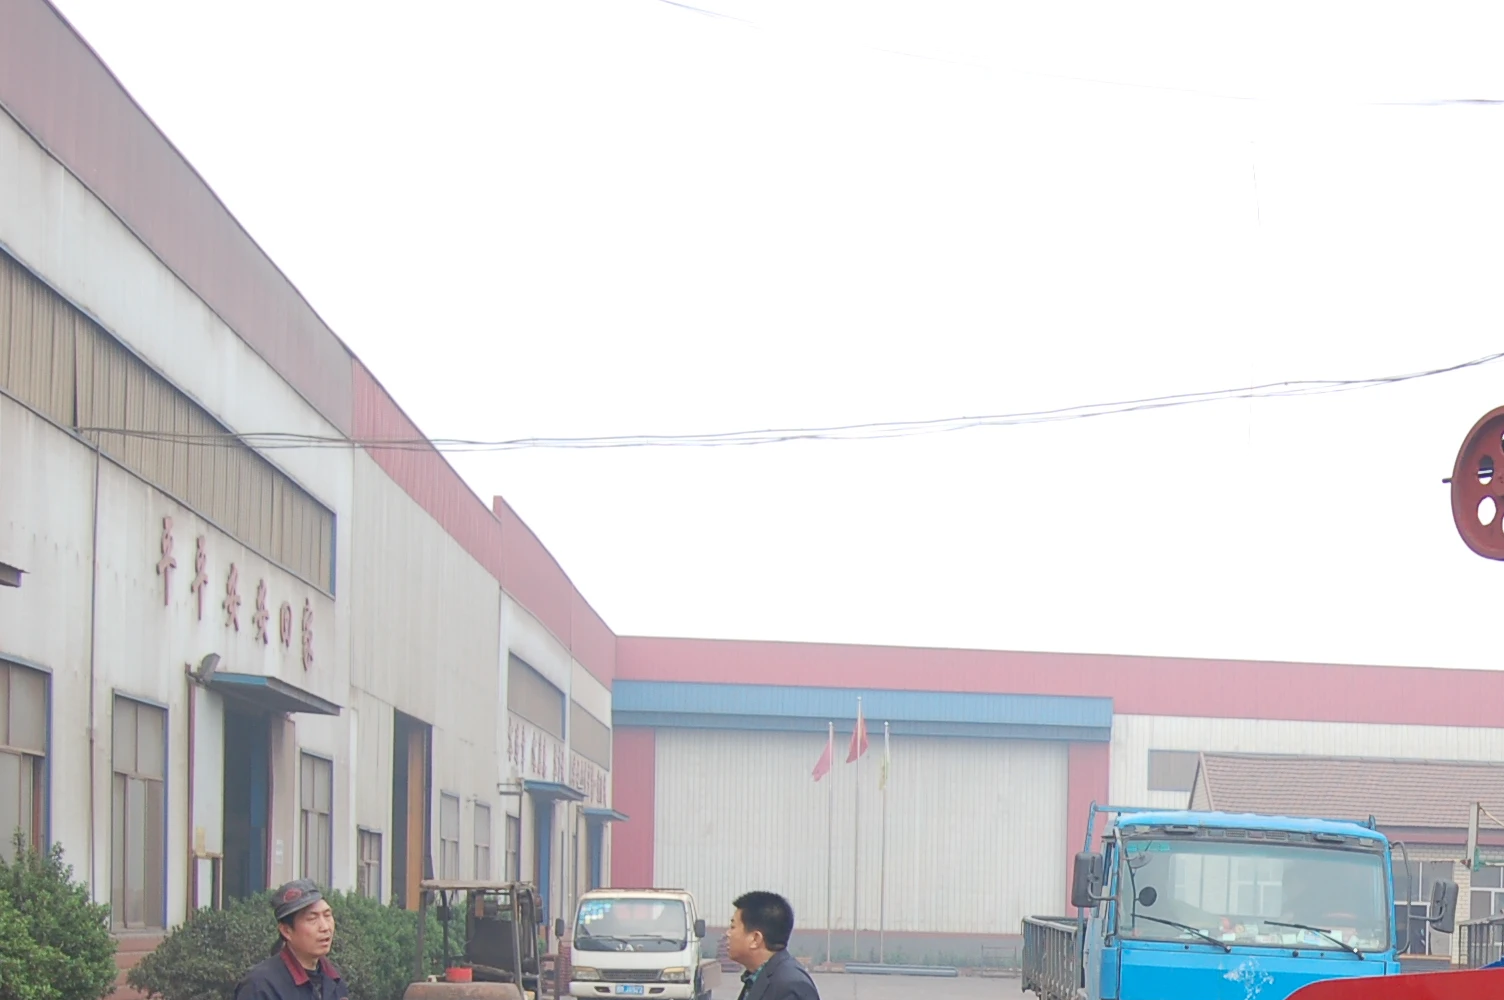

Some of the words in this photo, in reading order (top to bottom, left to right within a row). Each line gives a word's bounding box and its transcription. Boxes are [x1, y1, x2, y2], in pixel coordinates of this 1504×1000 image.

[156, 515, 314, 672] 平平安安回家
